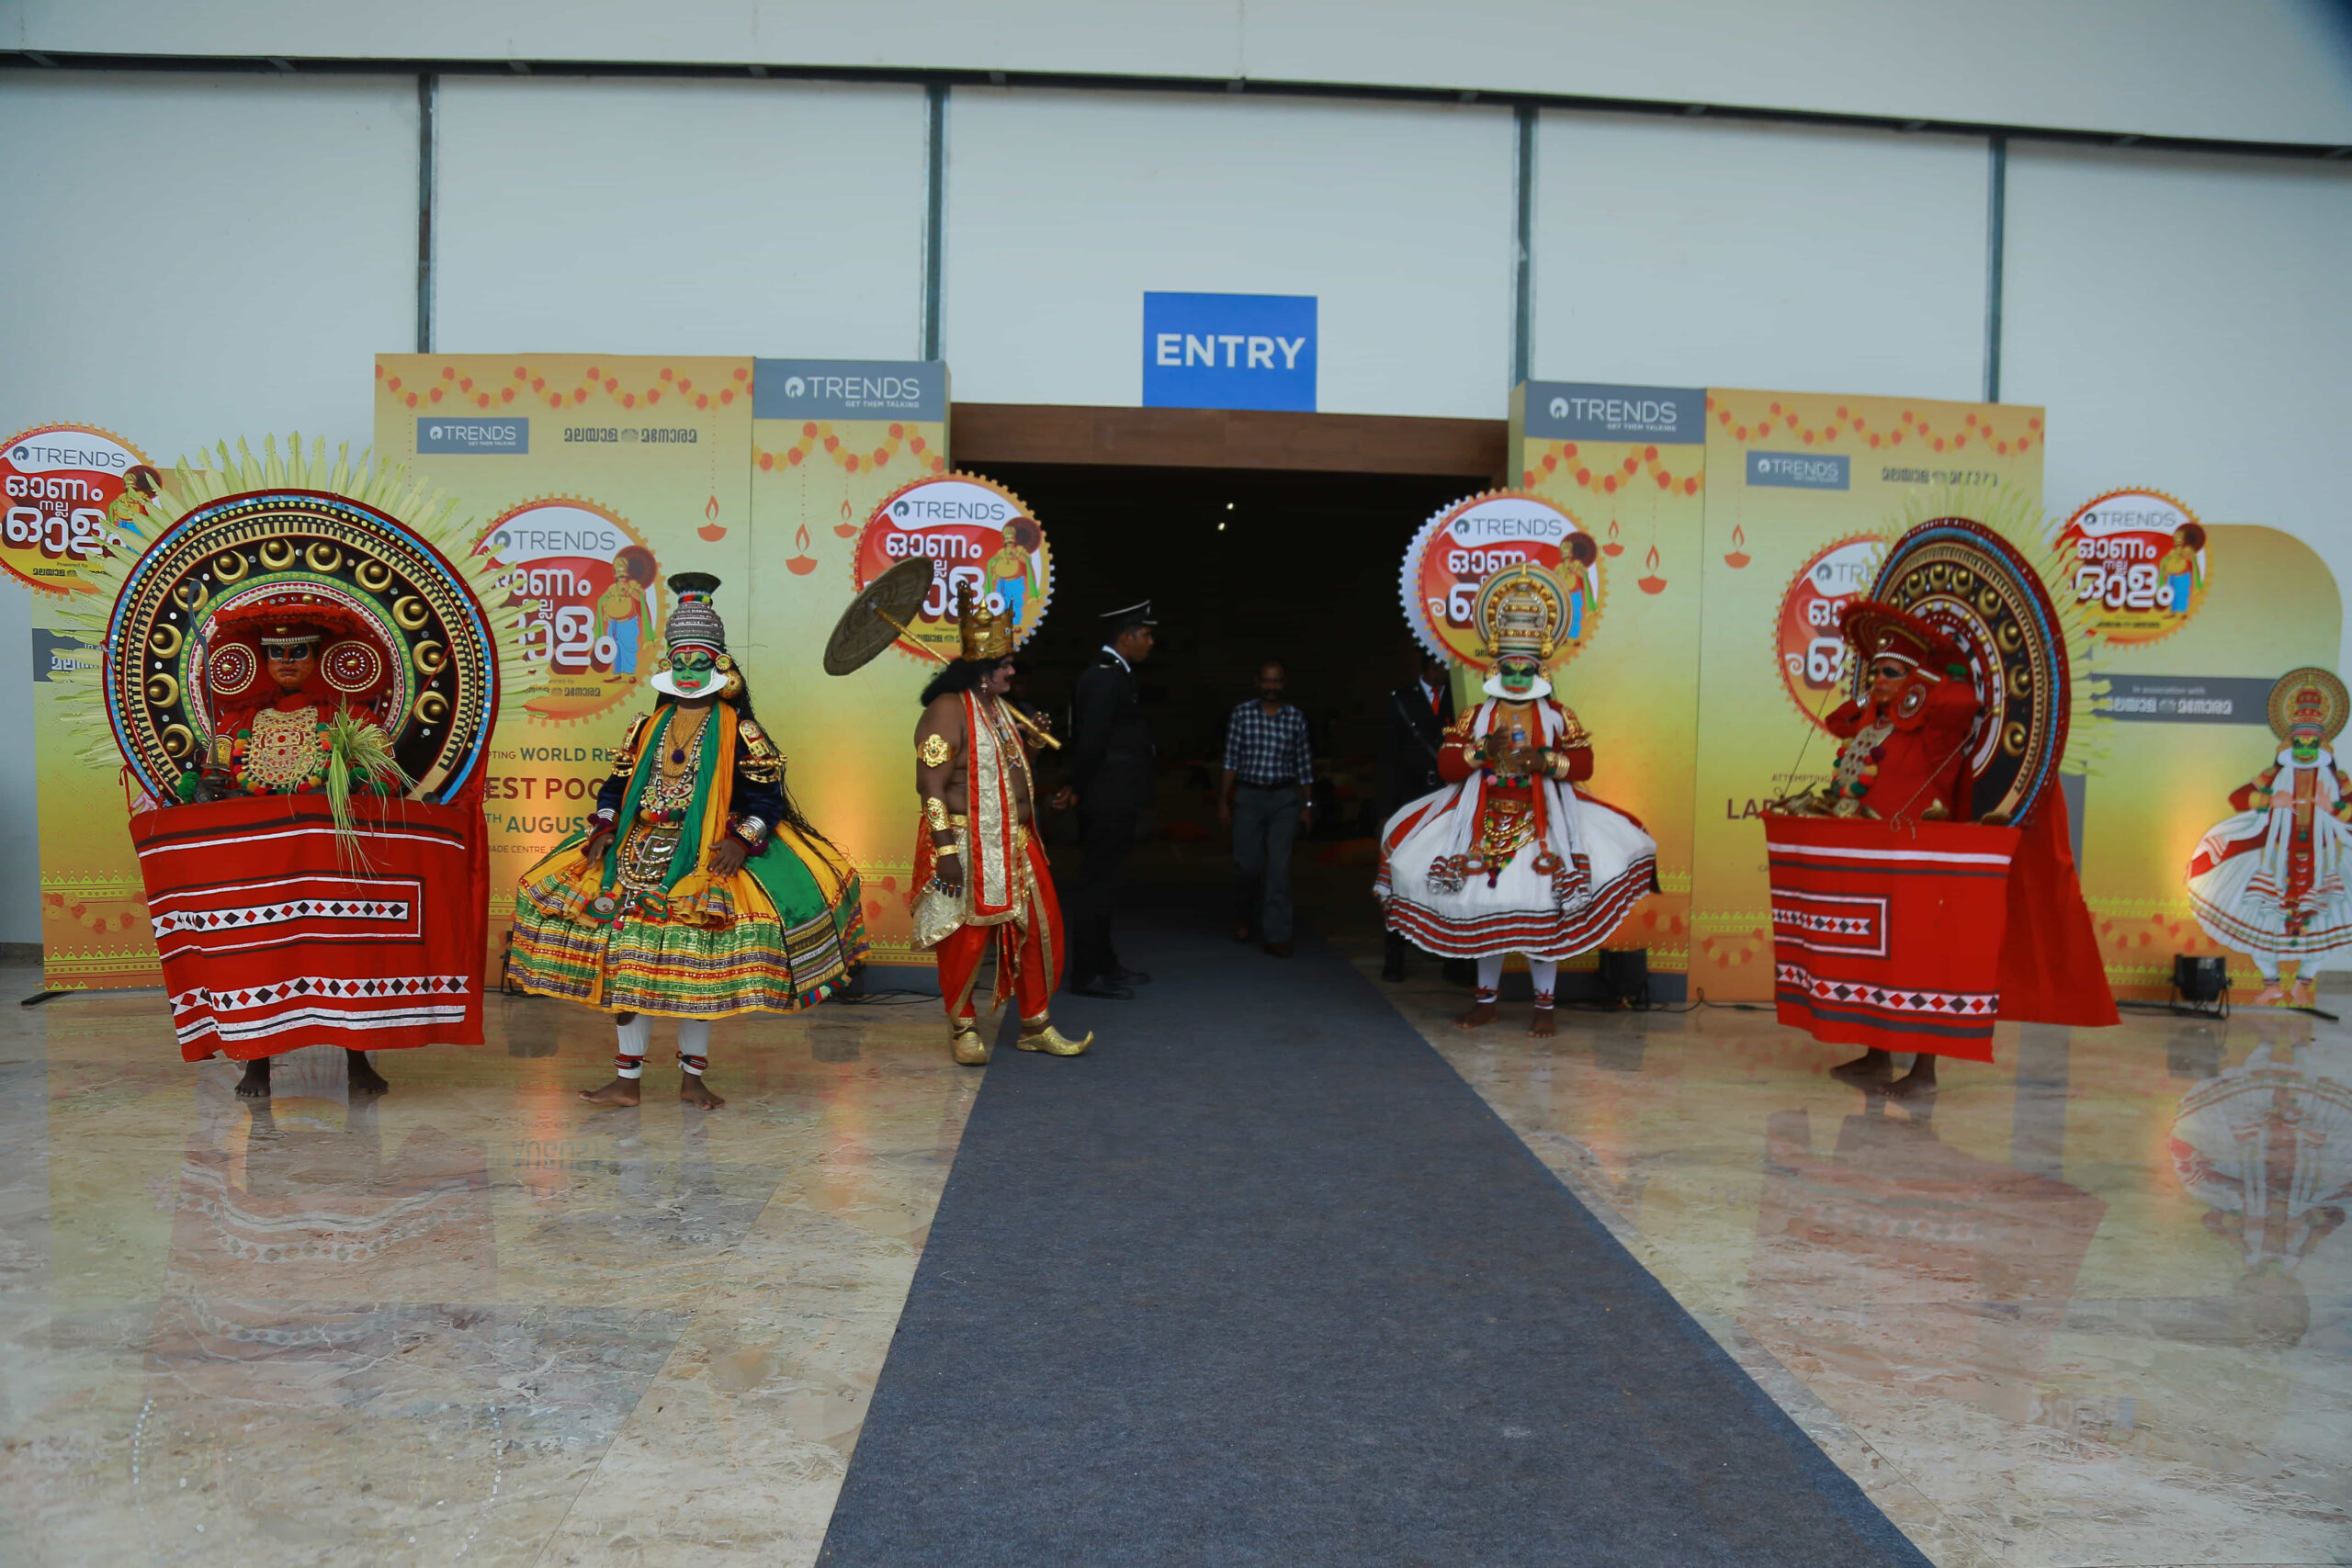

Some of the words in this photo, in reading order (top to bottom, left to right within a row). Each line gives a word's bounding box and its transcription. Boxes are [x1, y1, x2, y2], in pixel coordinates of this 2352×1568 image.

[1157, 333, 1306, 369] ENTRY
[807, 376, 921, 400] TRENDS
[1570, 397, 1677, 423] TRENDS
[444, 425, 516, 441] TRENDS
[563, 427, 618, 443] മലയാള
[640, 427, 697, 443] മനോരമ
[31, 446, 126, 468] TRENDS
[1771, 458, 1838, 477] TRENDS
[911, 501, 1005, 521] TRENDS
[2099, 510, 2177, 527] TRENDS
[1472, 518, 1562, 536] TRENDS
[514, 530, 616, 551] TRENDS
[520, 747, 586, 761] WORLD
[486, 777, 537, 800] EST
[505, 816, 586, 834] AUGUS
